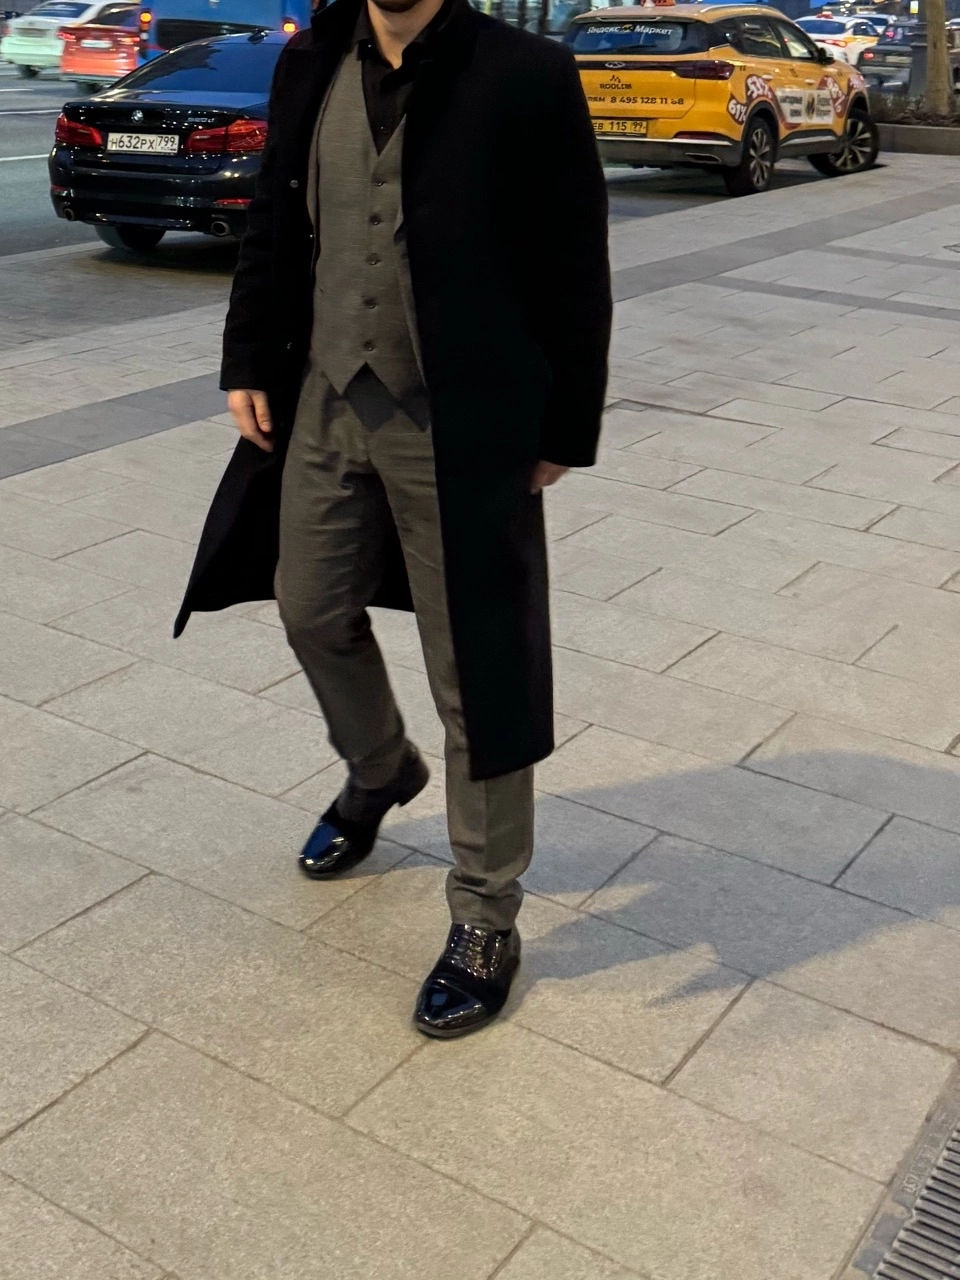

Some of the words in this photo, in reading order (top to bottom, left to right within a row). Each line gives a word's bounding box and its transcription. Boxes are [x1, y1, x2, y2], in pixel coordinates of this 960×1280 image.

[634, 25, 673, 35] Маркет
[609, 121, 627, 131] 115
[157, 135, 176, 147] 799
